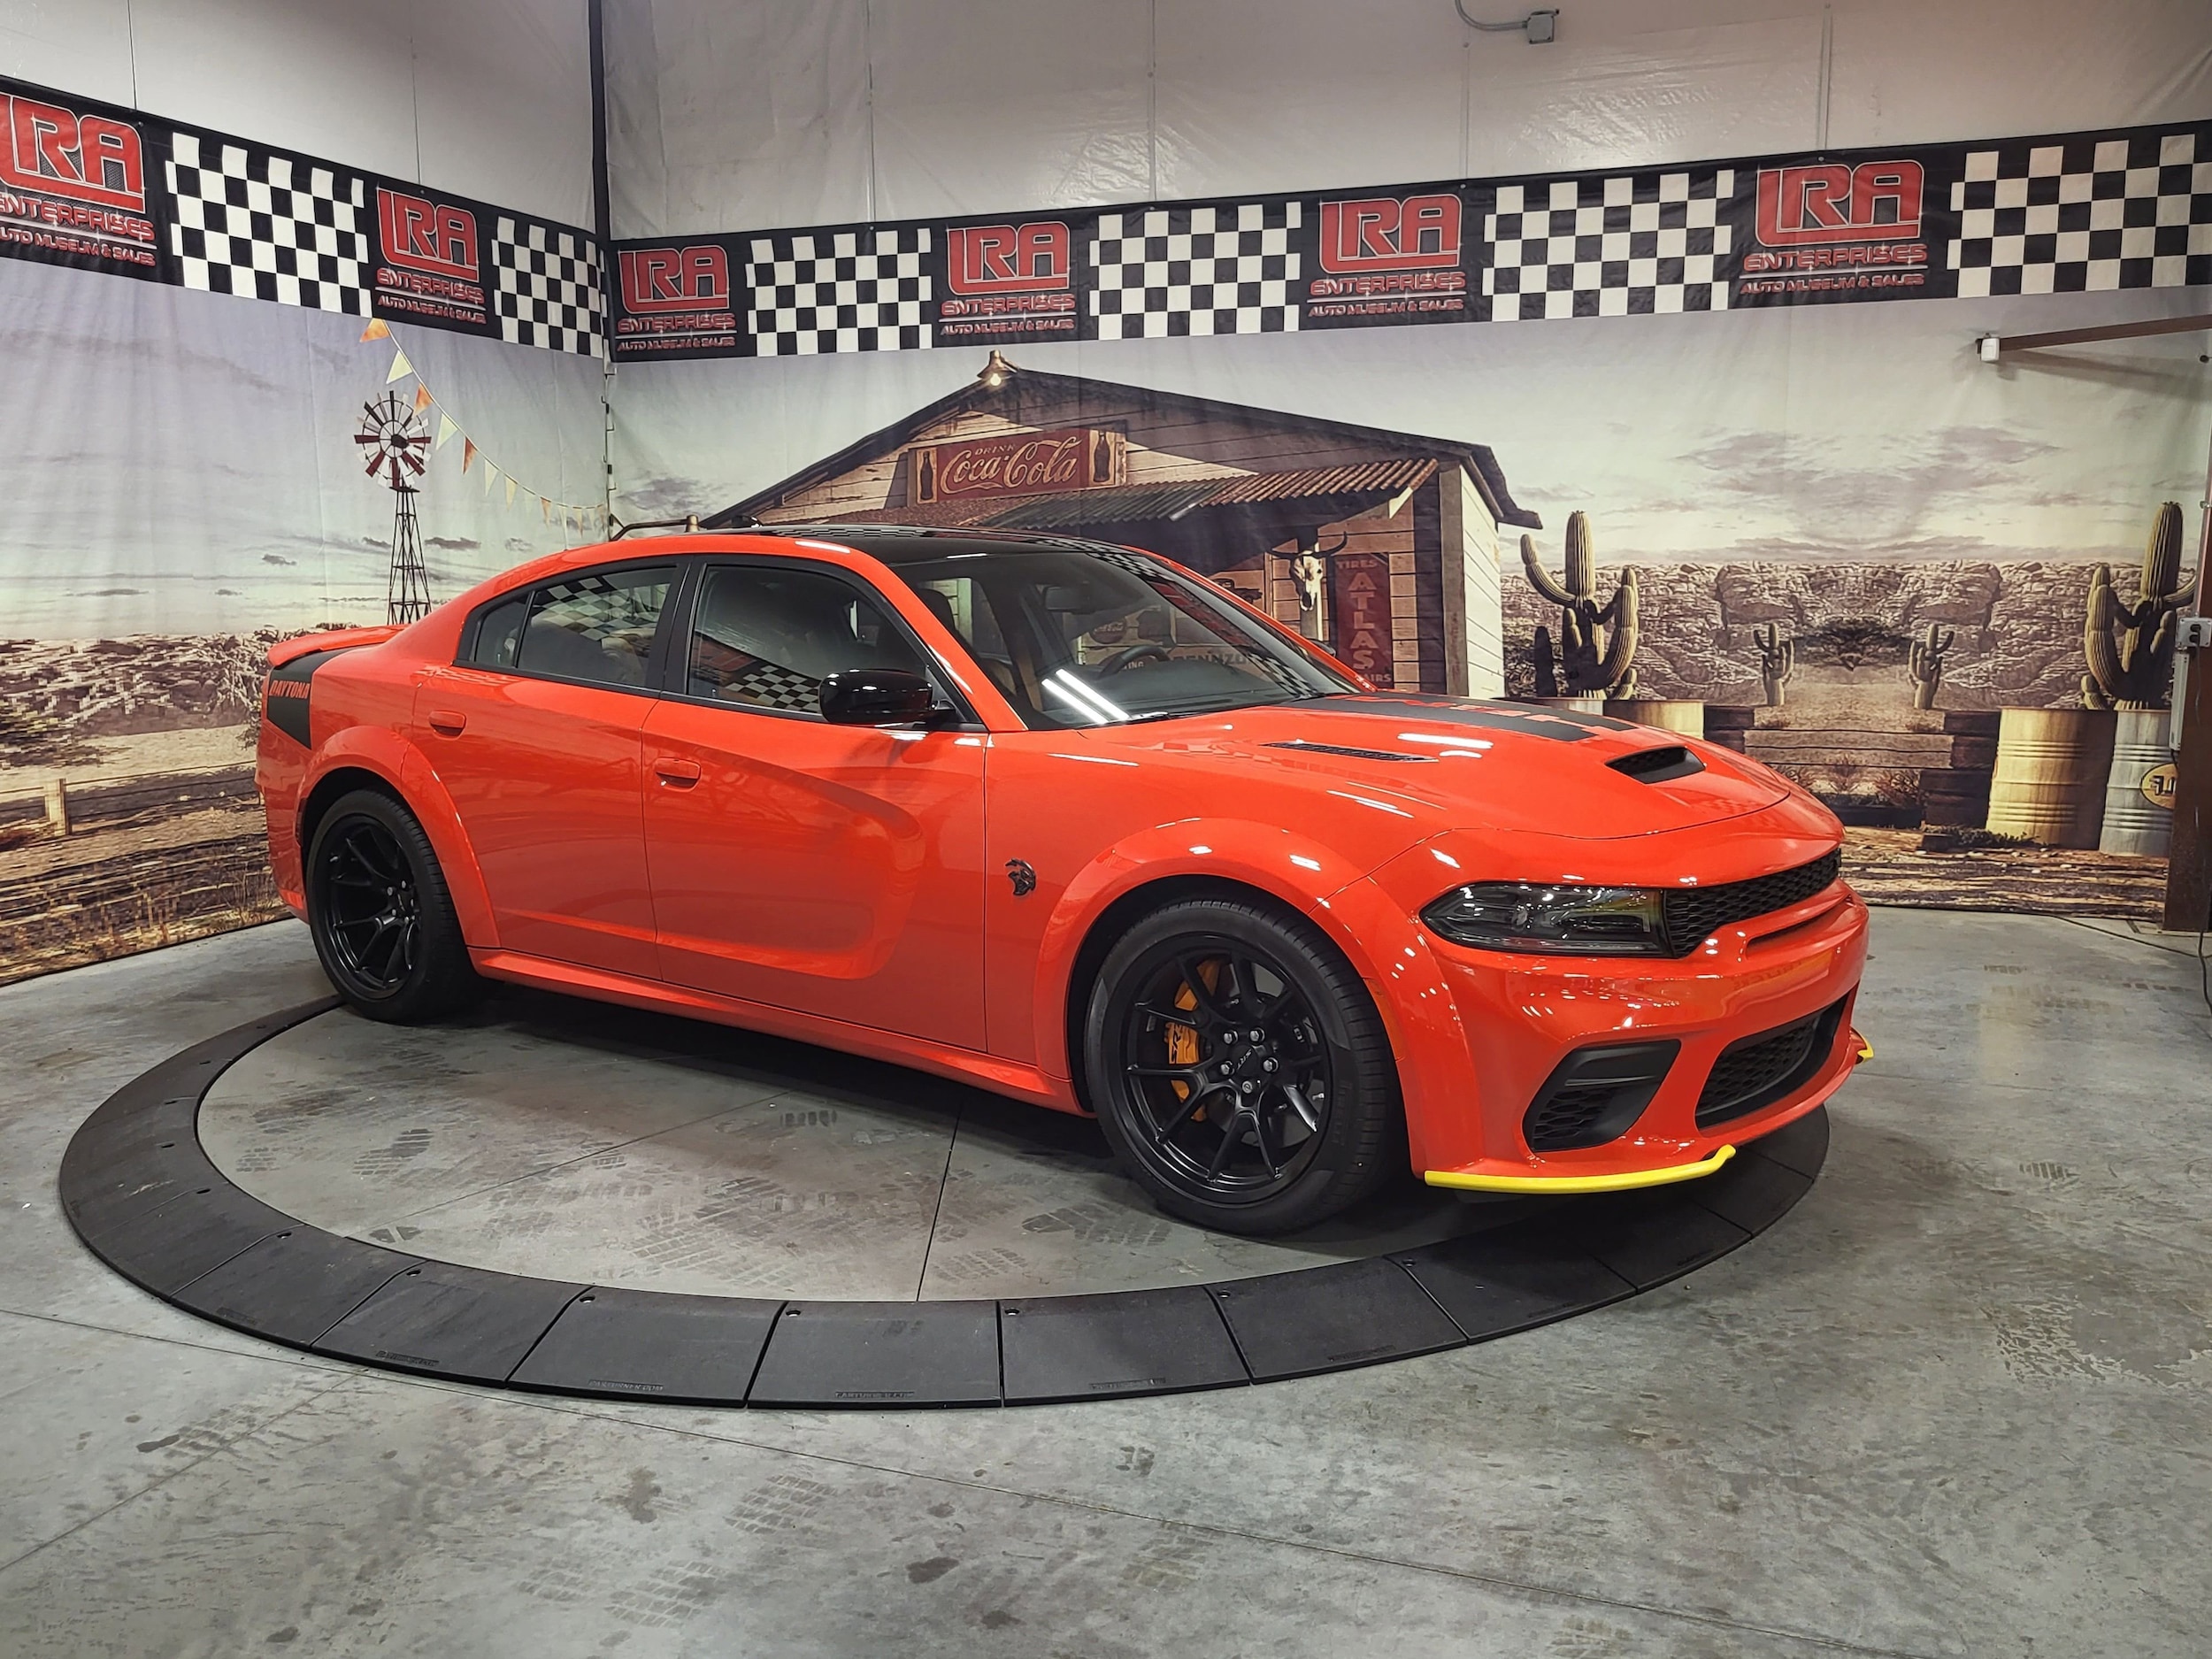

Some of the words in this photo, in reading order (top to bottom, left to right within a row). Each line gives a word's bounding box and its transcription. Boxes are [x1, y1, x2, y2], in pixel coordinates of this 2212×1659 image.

[1755, 159, 1924, 248] LRA
[377, 188, 480, 283] LRA
[1319, 194, 1462, 274] LRA
[0, 227, 34, 245] UTO
[35, 232, 99, 256] MUSEUM
[101, 244, 111, 257] &
[112, 247, 156, 266] SALES
[947, 220, 1071, 296] LRA
[1743, 244, 1928, 272] ENTERPRISES
[376, 267, 485, 304] ENTERPRISES
[618, 244, 730, 314] LRA
[1310, 272, 1466, 296] ENTERPRISES
[1740, 281, 1785, 295] AUTO
[1786, 278, 1855, 292] MUSEUM
[1857, 276, 1870, 288] &
[1871, 274, 1925, 288] SALES
[378, 295, 406, 311] AUTO
[941, 293, 1076, 316] ENTERPRISES
[1308, 306, 1345, 317] AUTO
[1347, 303, 1406, 315] MUSEUM
[1408, 301, 1417, 312] &
[1418, 299, 1464, 311] SALES
[618, 313, 736, 334] ENTERPRISES
[941, 325, 972, 336] AUTO
[1035, 319, 1075, 331] SALES
[618, 340, 647, 351] AUTO
[974, 443, 1016, 456] DRINK
[940, 436, 1082, 495] Coca-Cola
[1336, 559, 1378, 569] TIRES
[1348, 572, 1380, 670] ATLAS
[1364, 673, 1392, 682] AIRS
[268, 680, 311, 699] DAYTONA
